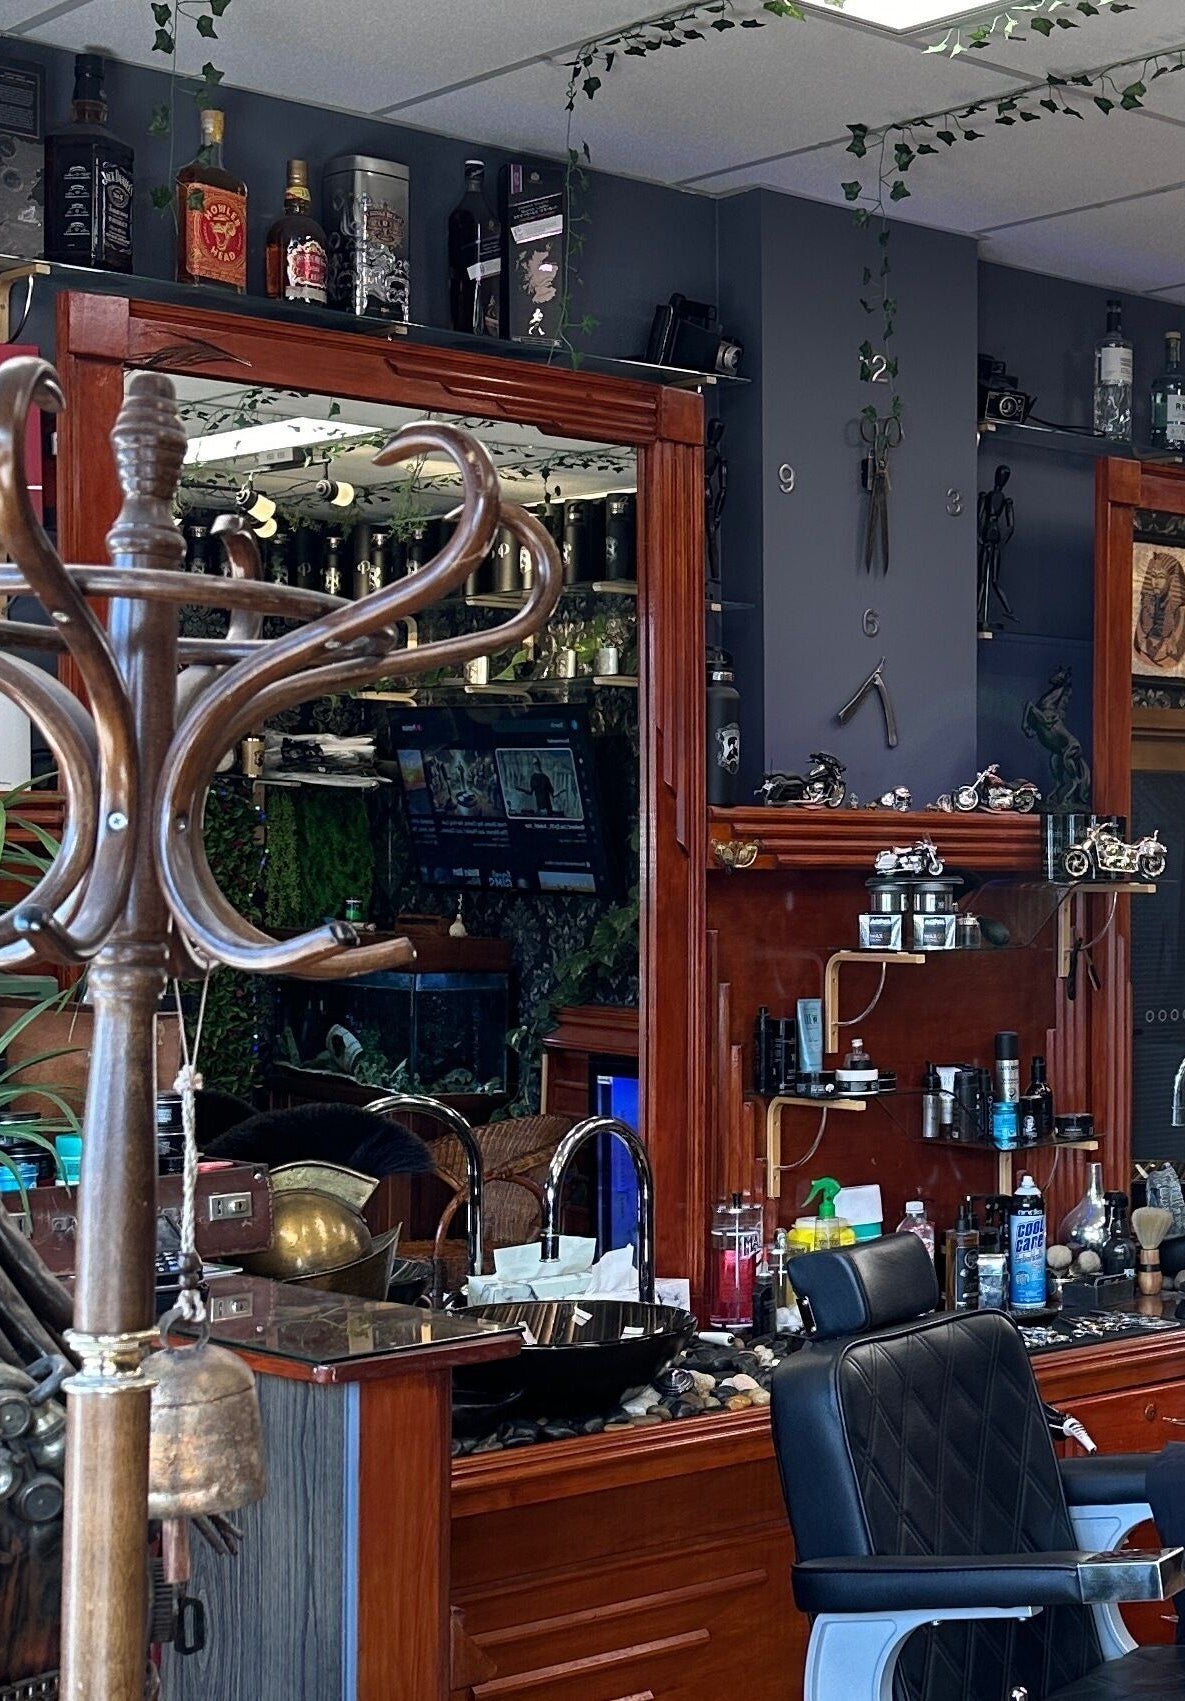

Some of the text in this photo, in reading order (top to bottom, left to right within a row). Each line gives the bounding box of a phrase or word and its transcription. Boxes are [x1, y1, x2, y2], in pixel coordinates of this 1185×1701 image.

[204, 203, 241, 227] HOWLER
[210, 246, 236, 263] HEAD
[778, 463, 796, 494] 9
[945, 487, 963, 517] 3
[862, 608, 880, 637] 6
